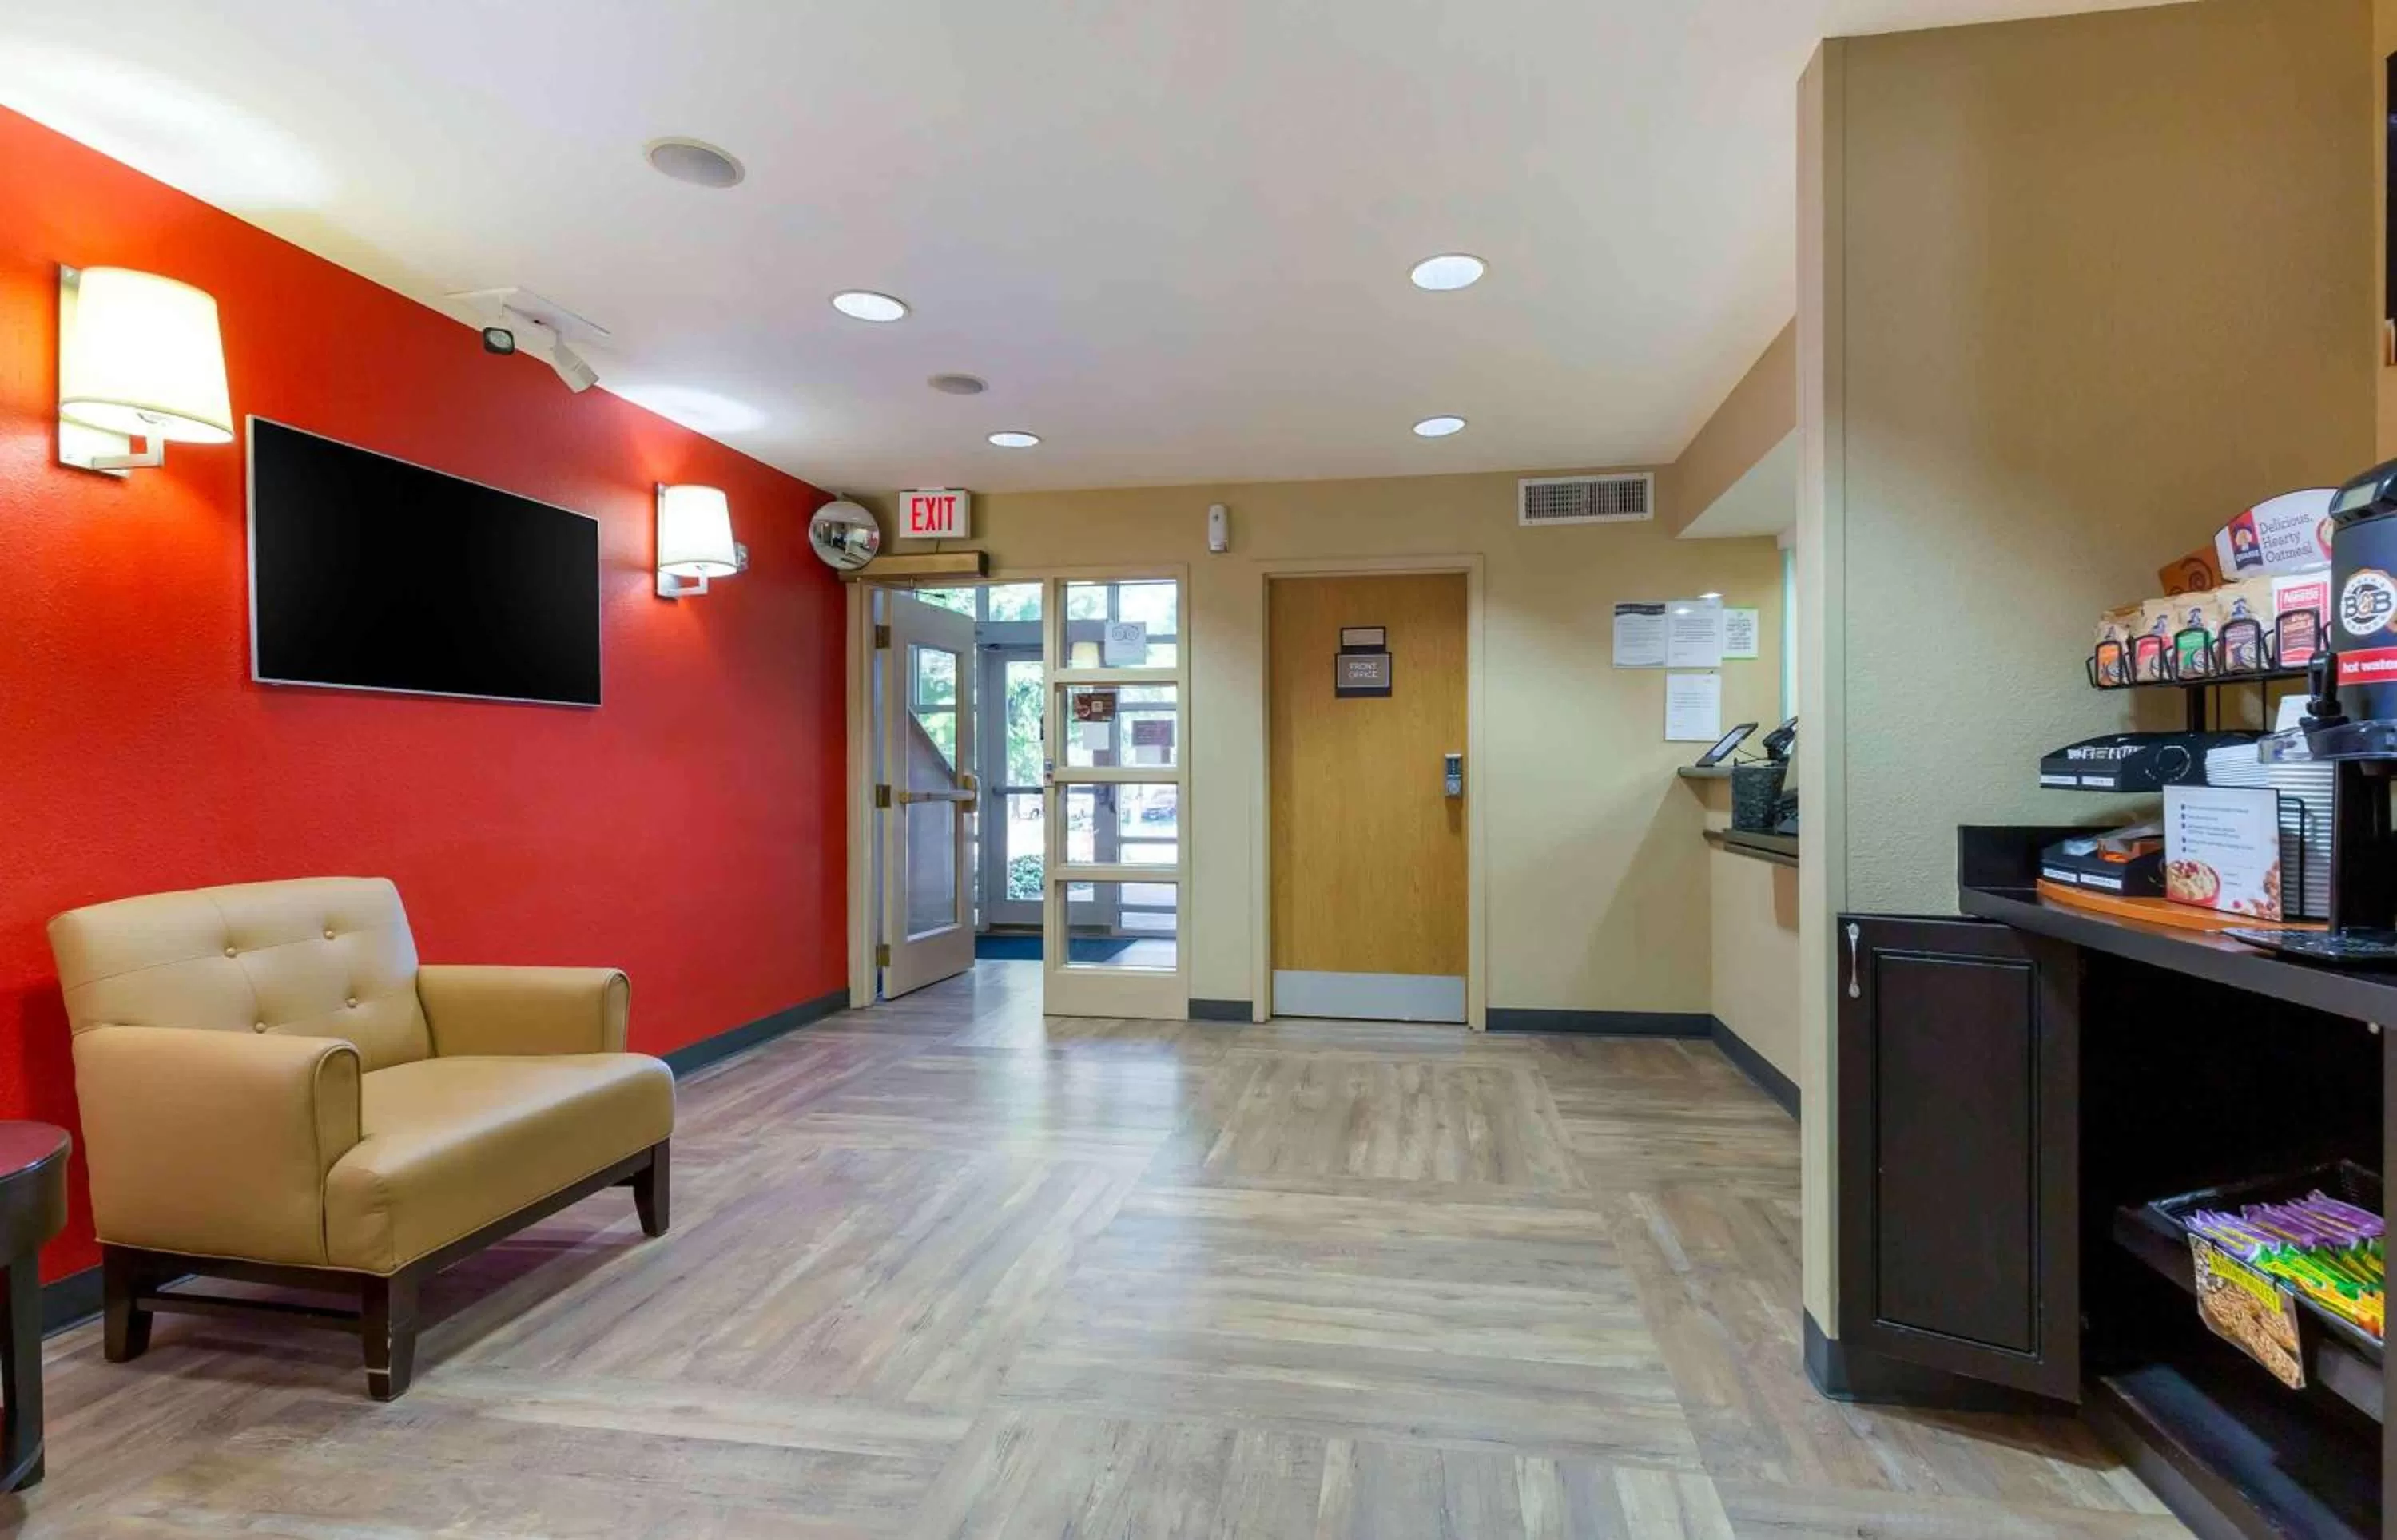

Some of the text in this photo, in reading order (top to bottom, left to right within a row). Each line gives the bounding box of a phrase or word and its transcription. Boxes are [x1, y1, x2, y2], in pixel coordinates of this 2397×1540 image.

[910, 496, 956, 531] EXIT
[2262, 531, 2300, 549] Hearty
[2265, 540, 2313, 563] Oatmeal
[2342, 658, 2397, 674] hot wate
